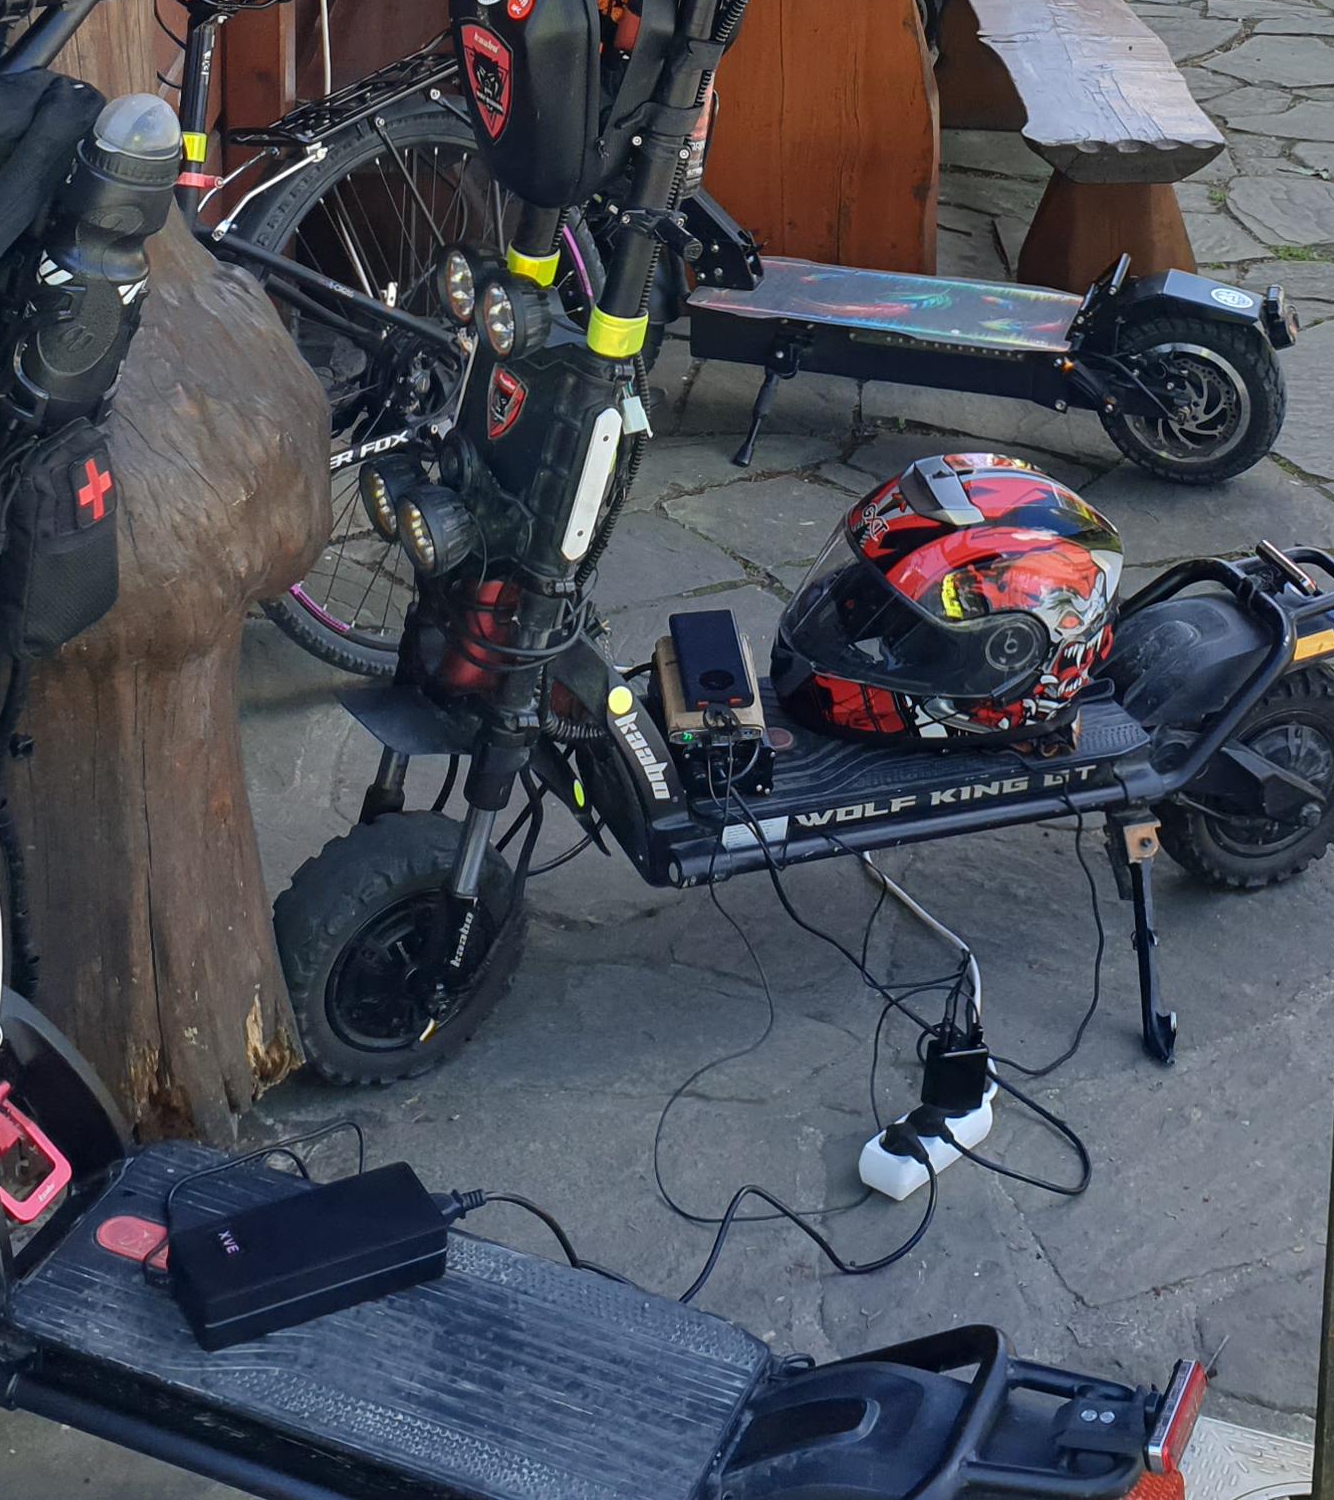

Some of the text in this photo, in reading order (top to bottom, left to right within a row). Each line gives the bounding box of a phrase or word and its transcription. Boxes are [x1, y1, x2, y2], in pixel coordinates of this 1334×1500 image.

[360, 430, 409, 458] FOX
[614, 711, 671, 800] kaabo
[795, 795, 917, 828] WOLF
[930, 776, 1030, 807] KING
[1043, 764, 1098, 787] GT
[450, 911, 474, 968] kaabo
[218, 1230, 240, 1254] XVE
